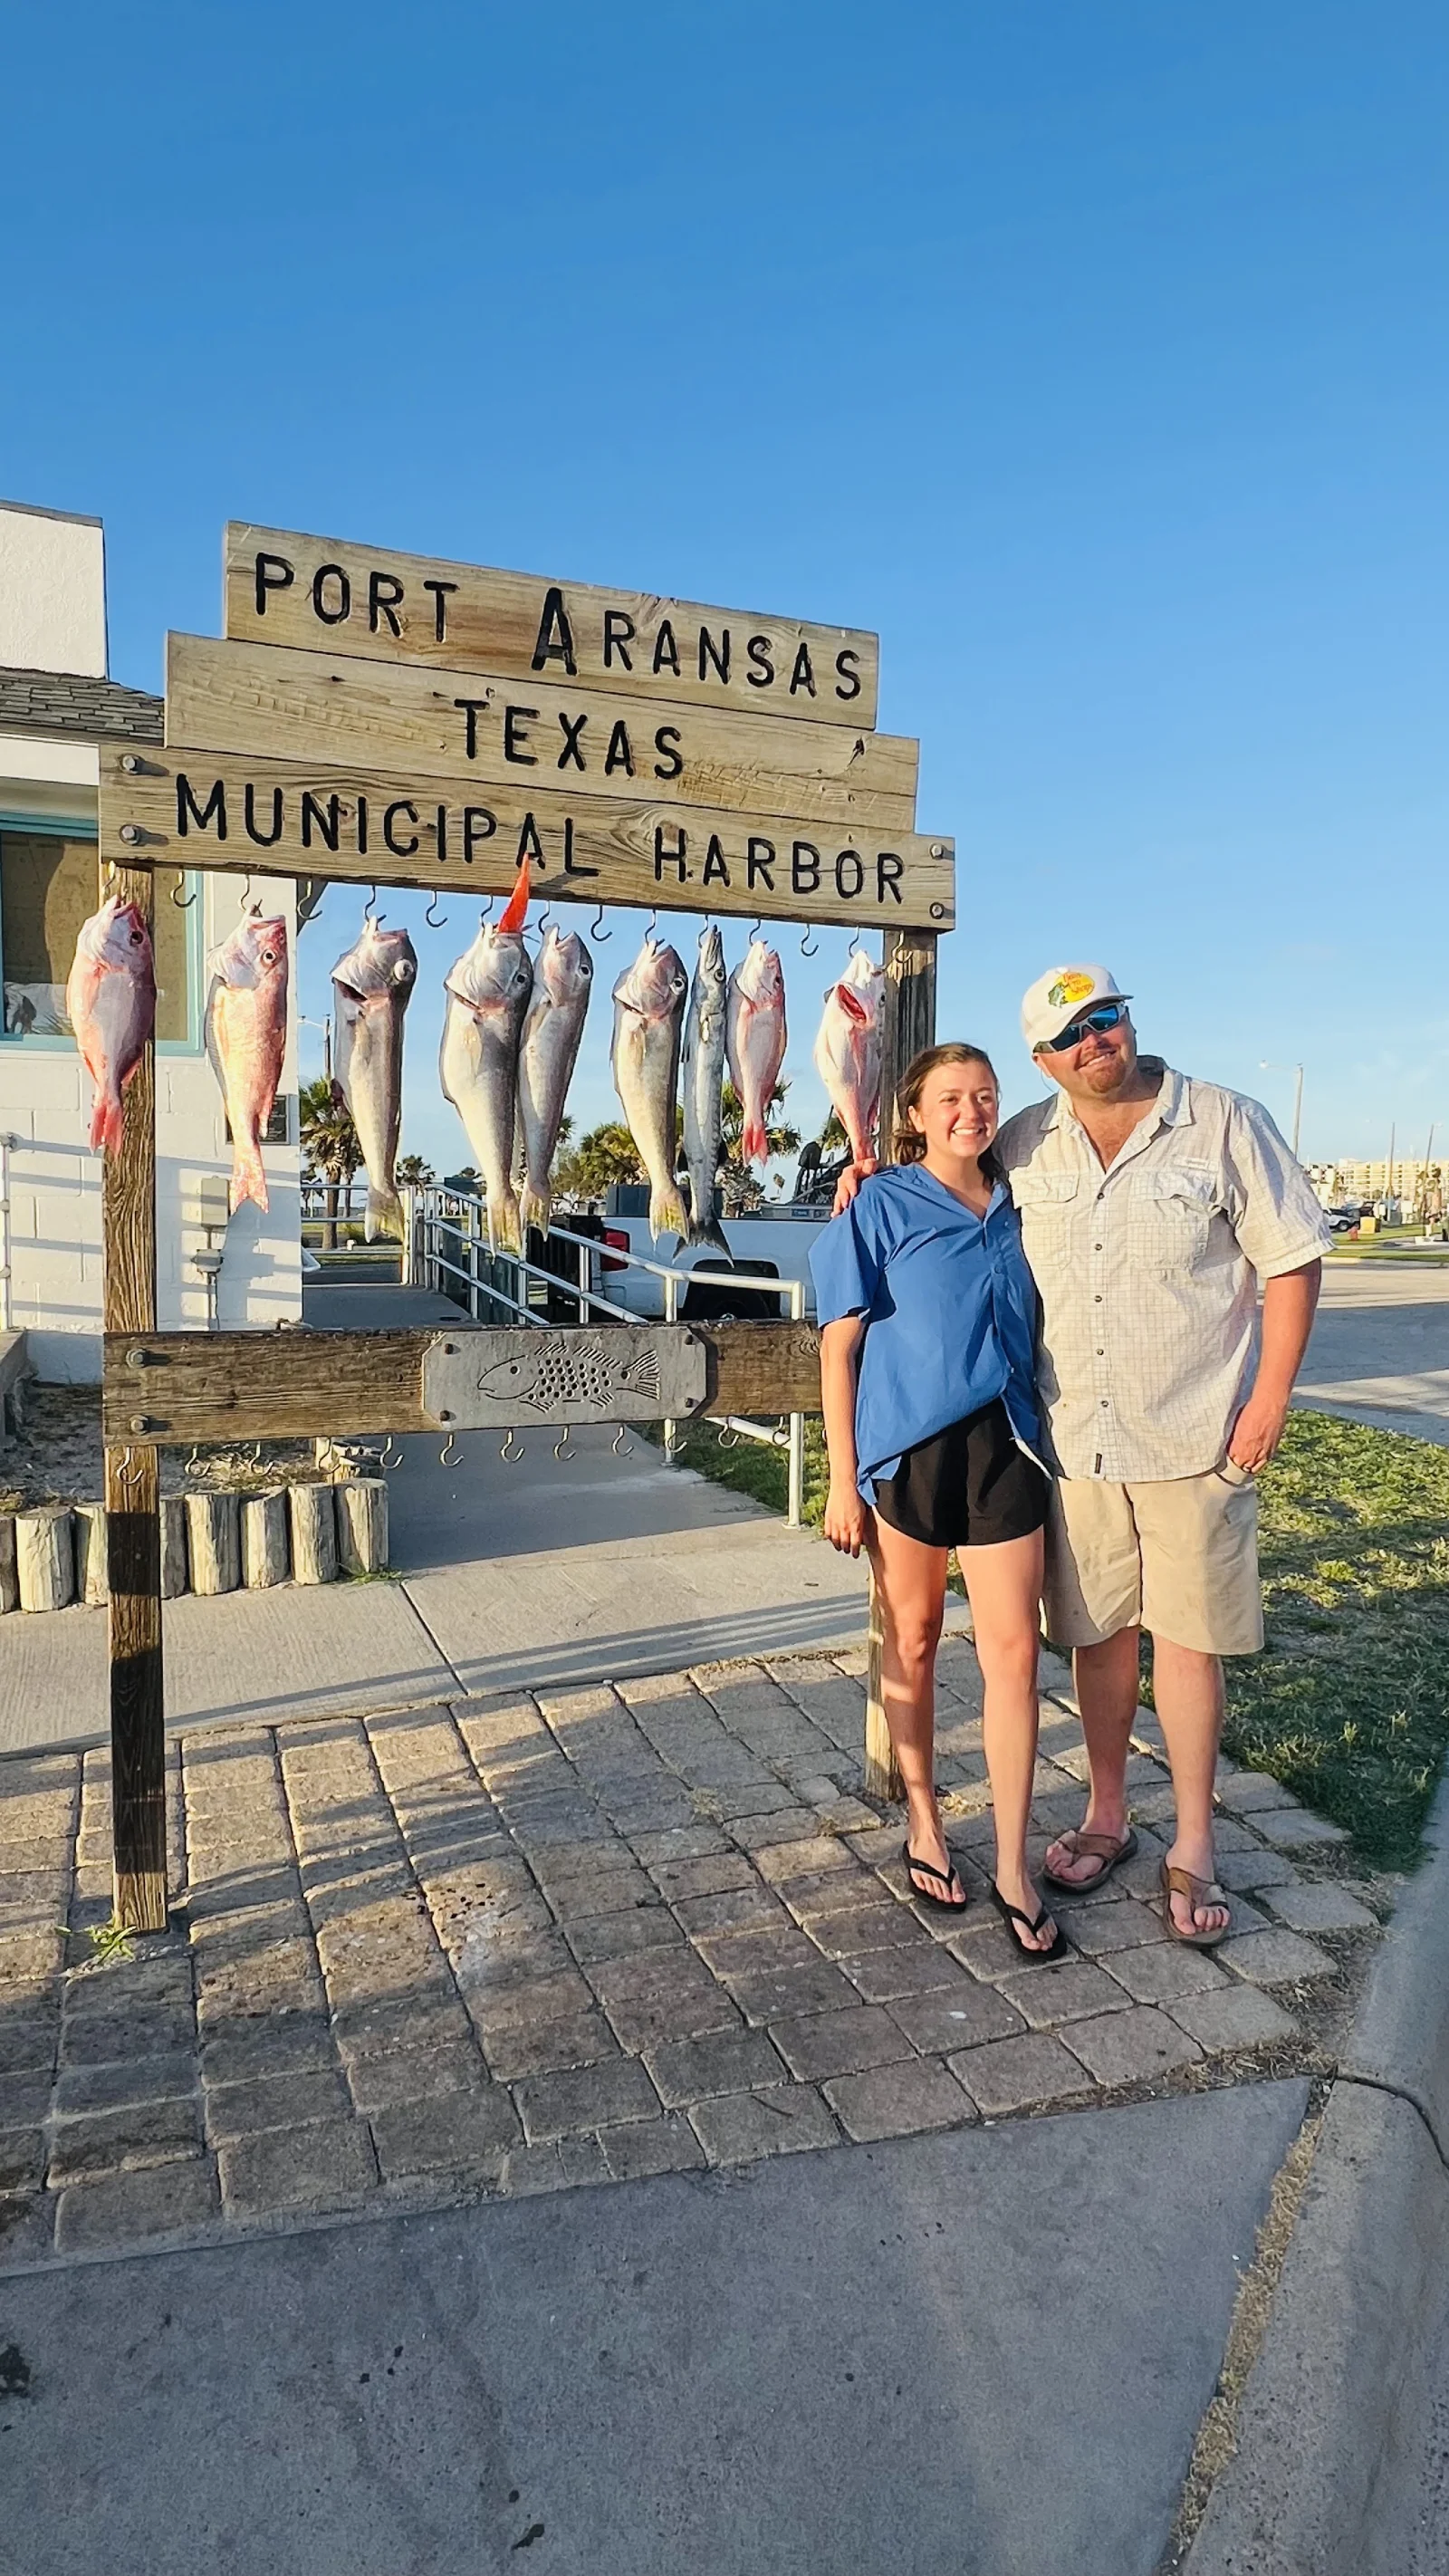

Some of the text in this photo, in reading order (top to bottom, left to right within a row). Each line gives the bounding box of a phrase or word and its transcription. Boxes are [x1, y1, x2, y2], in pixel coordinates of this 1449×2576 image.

[255, 552, 861, 700] PORT ARANSAS
[454, 698, 684, 780] TEXAS
[176, 773, 904, 905] MUNICIPAL HARBOR
